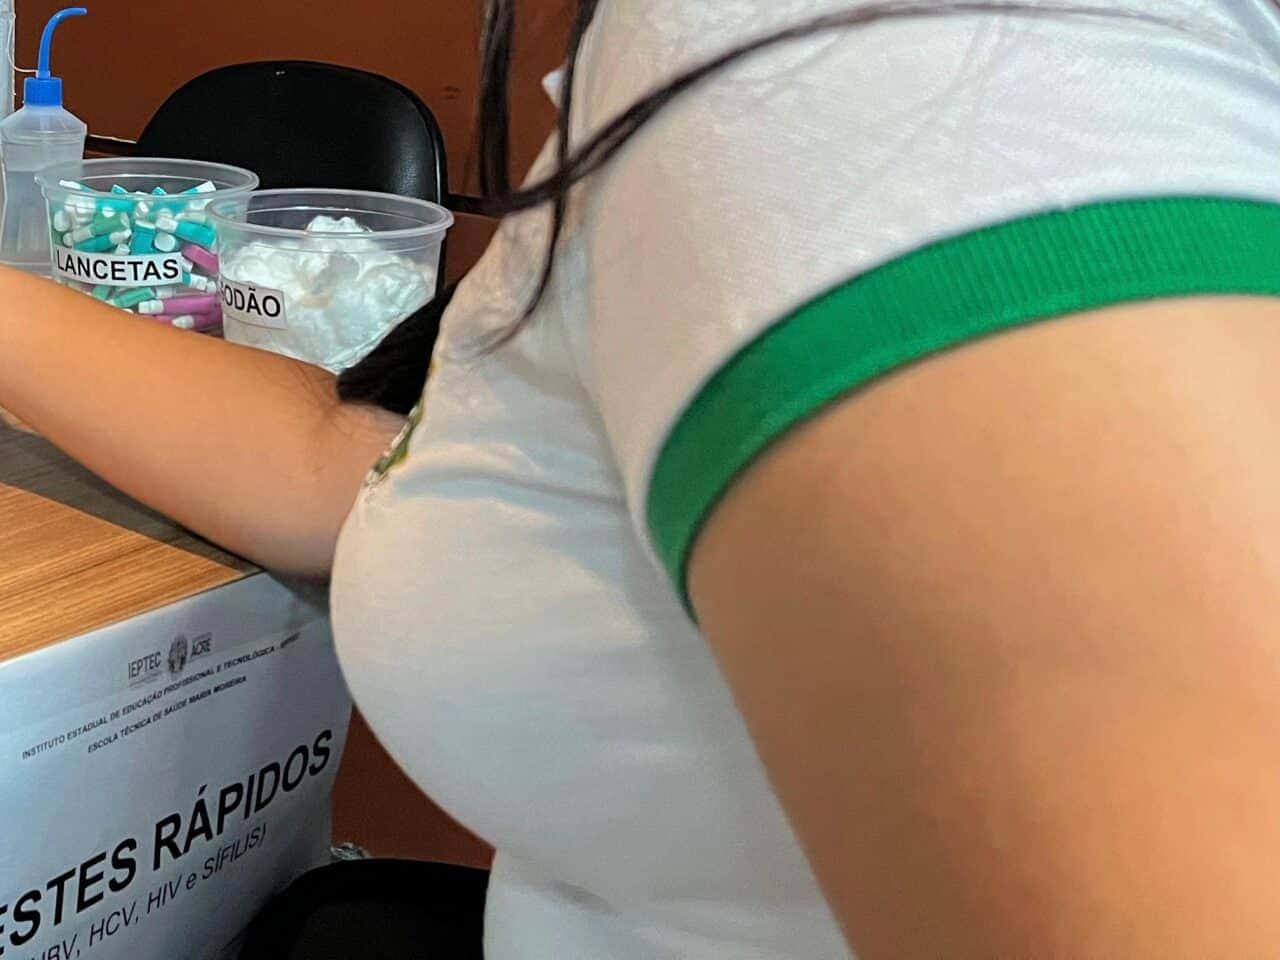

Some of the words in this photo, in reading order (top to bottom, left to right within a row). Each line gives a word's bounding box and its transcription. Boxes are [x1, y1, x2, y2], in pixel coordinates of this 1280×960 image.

[56, 248, 179, 281] LANCETAS
[22, 735, 65, 760] INSTITUTO
[67, 716, 108, 740] ESTADUAL
[110, 710, 120, 721] DE
[122, 690, 162, 716] EDUCAÇÃO
[163, 668, 215, 696] PROFISSIONAL
[224, 646, 275, 670] TECNOLÓGICA
[128, 651, 161, 680] IEPTEC
[87, 733, 118, 754] ESCOLA
[120, 717, 151, 738] TÉCNICA
[152, 710, 162, 722] DE
[188, 688, 211, 704] MARIA
[153, 729, 333, 871] RÁPIDOS
[89, 902, 139, 947] HCV,
[147, 874, 182, 914] HIV
[186, 872, 197, 890] e
[202, 823, 266, 880] SÍFILIS)
